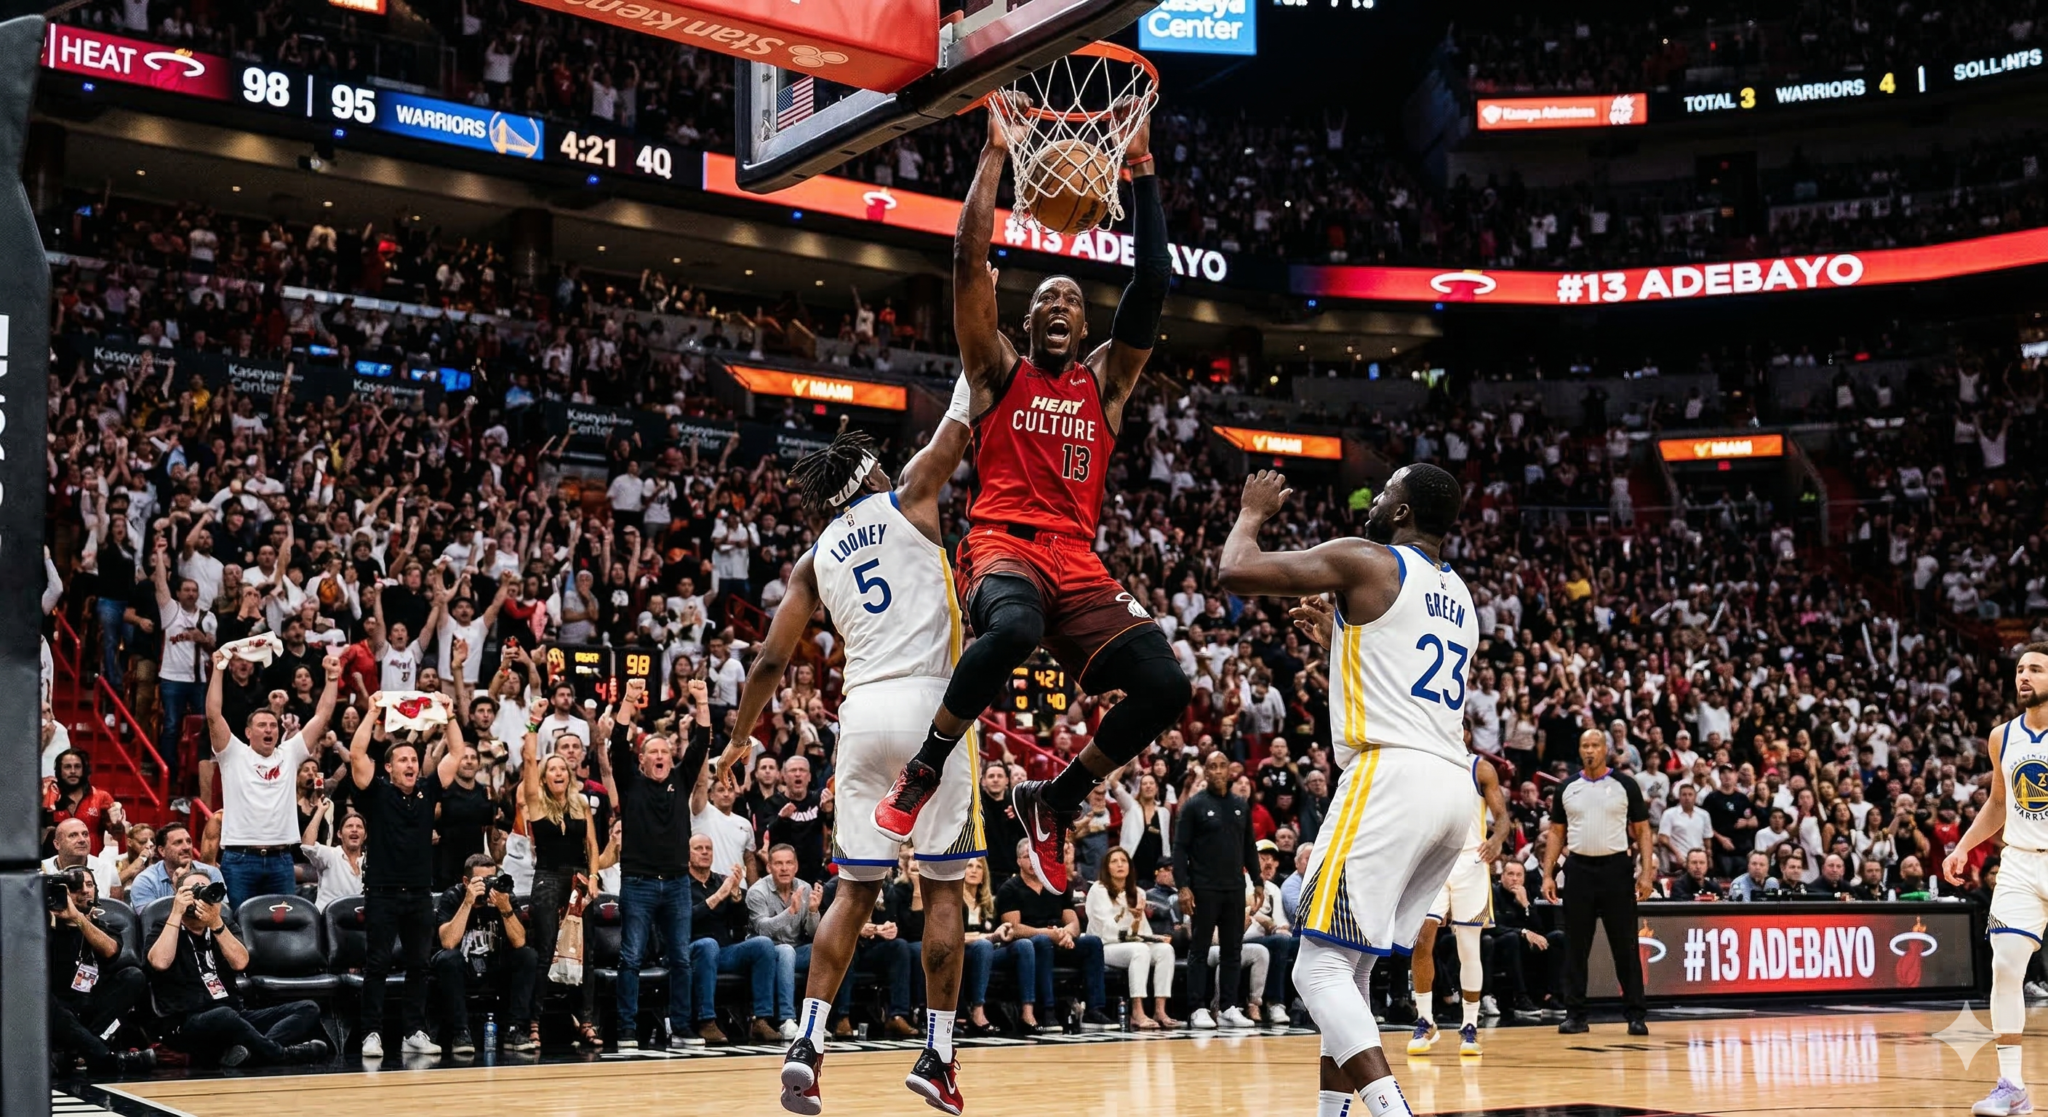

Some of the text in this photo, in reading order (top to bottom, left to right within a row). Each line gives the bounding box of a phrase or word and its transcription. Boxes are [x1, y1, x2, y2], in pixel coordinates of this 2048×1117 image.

[1148, 11, 1244, 40] Center
[1160, 0, 1247, 19] aseya
[61, 35, 138, 75] HEAT
[684, 20, 786, 56] Stan
[242, 66, 290, 107] 98
[331, 84, 376, 124] 95
[1684, 92, 1736, 113] TOTAL
[1739, 86, 1757, 109] 3
[1775, 78, 1866, 104] WARRIORS
[1878, 71, 1897, 94] 4
[395, 104, 487, 139] WARRIORS
[559, 130, 673, 180] 4:21 4Q
[1070, 229, 1228, 283] ADEAYO
[1557, 253, 1864, 303] #13 ADEBAYO
[228, 362, 275, 383] Kaseya
[809, 379, 854, 402] MIAMI
[1030, 395, 1086, 416] HEAT
[1012, 409, 1096, 442] CULTURE
[1062, 443, 1092, 482] 13
[1711, 439, 1753, 457] MIAMI
[830, 523, 888, 564] LOONEY
[852, 557, 892, 614] 5
[1424, 592, 1466, 629] GREEN
[626, 654, 650, 675] 98
[1410, 633, 1469, 711] 23
[1684, 926, 1876, 982] #13 ADEBAYO
